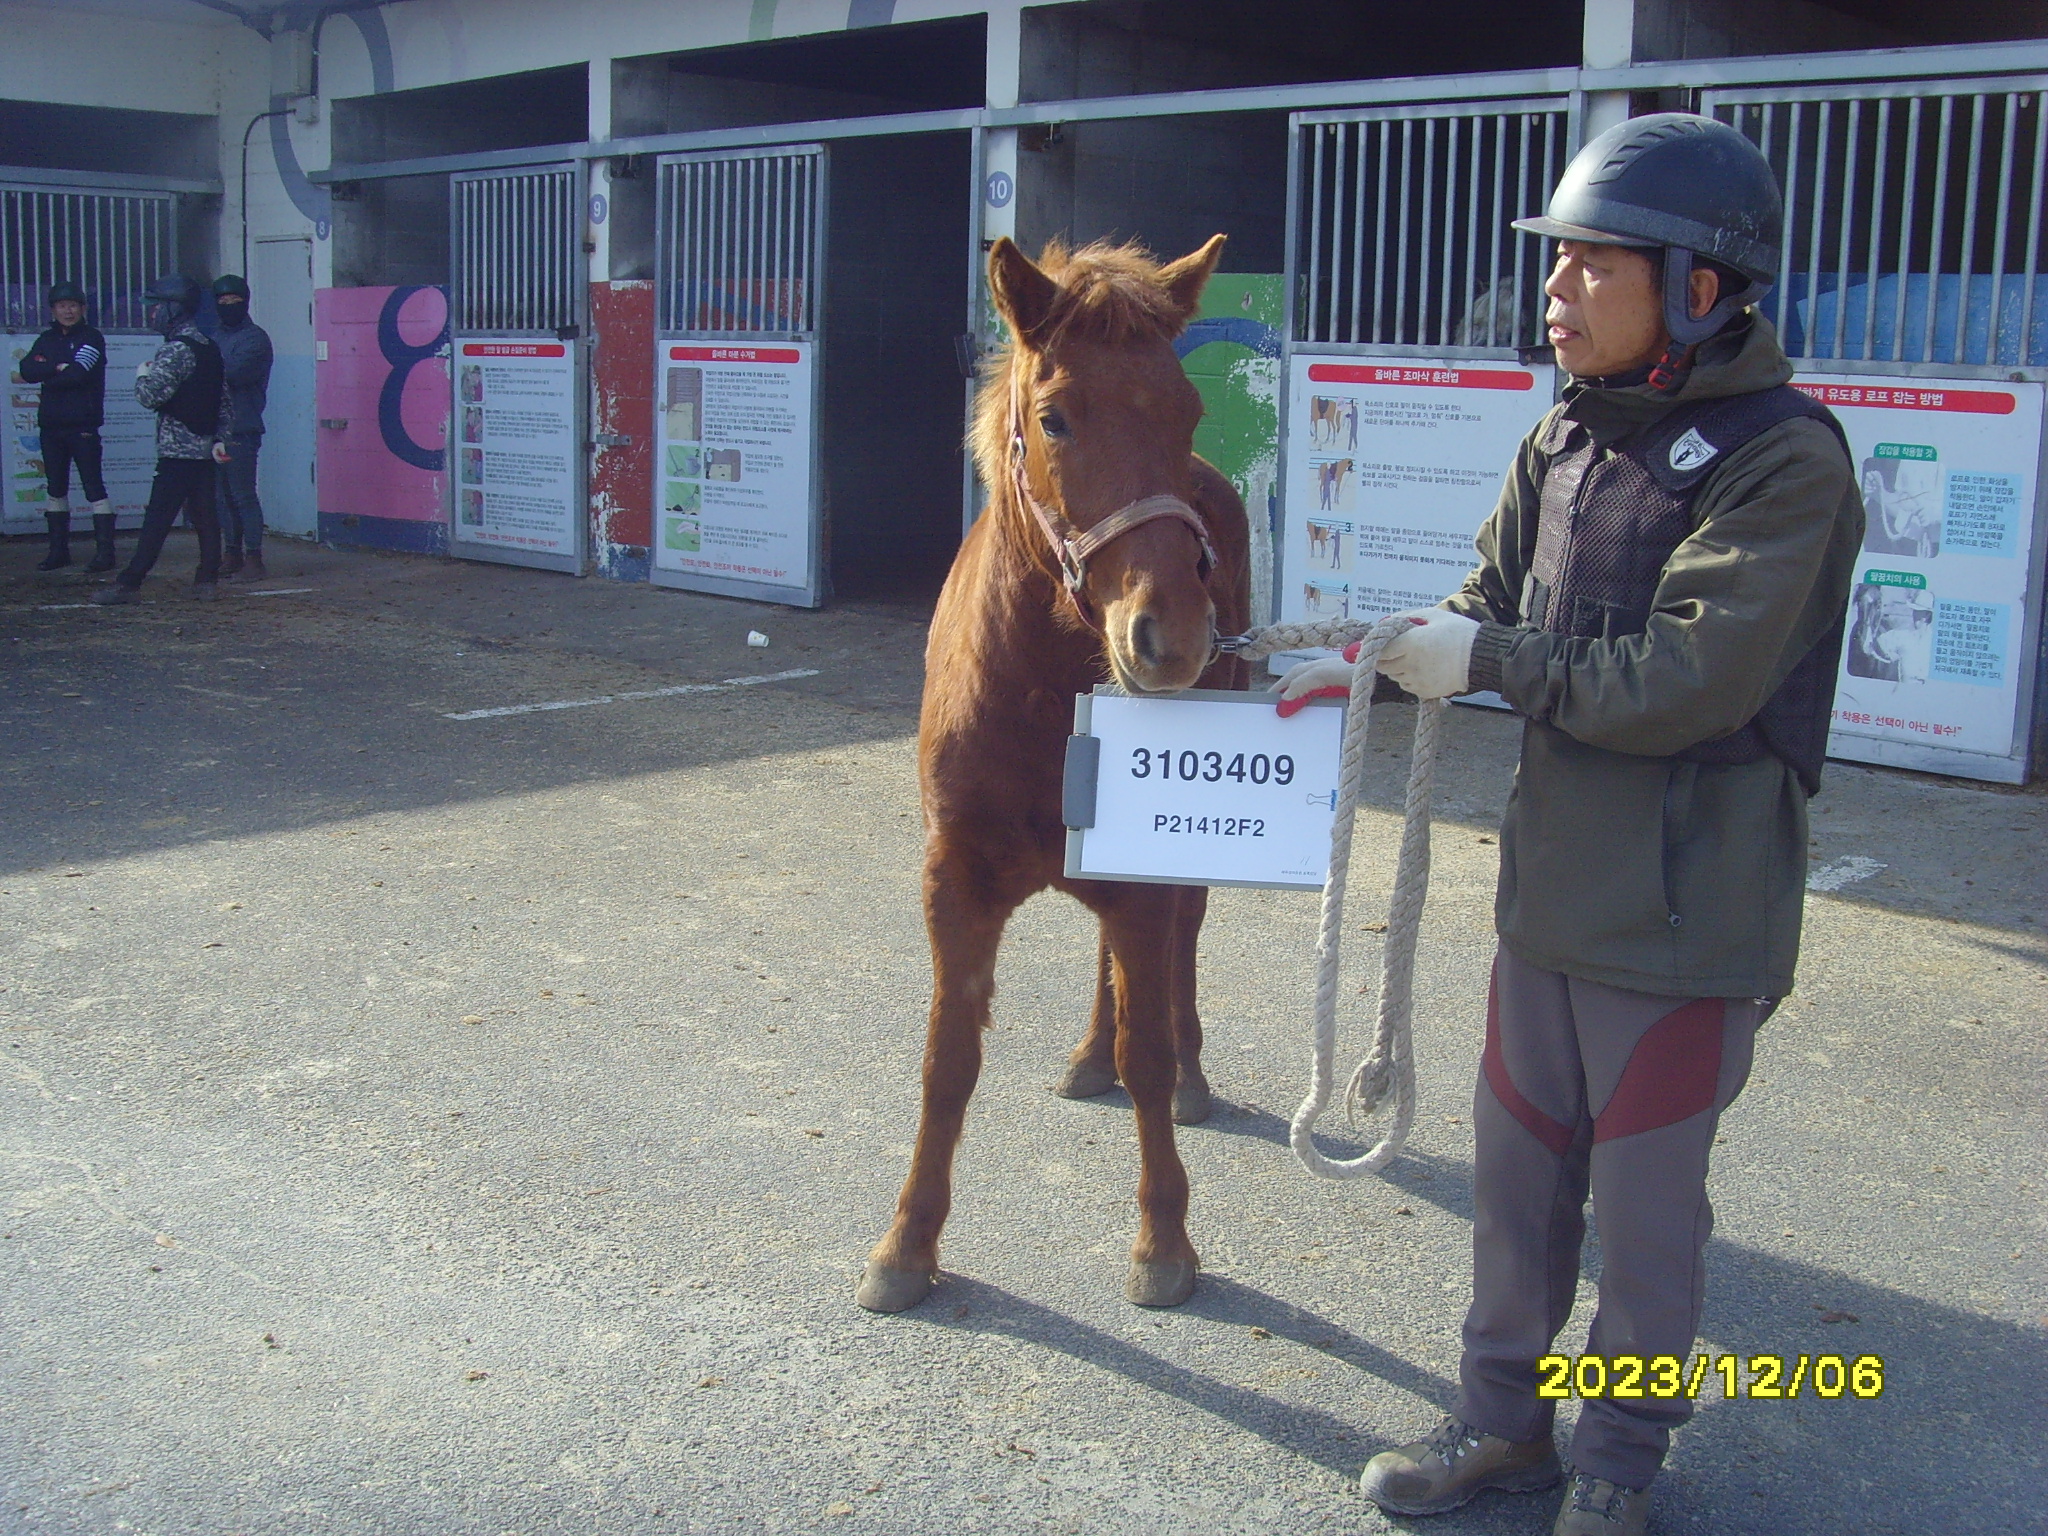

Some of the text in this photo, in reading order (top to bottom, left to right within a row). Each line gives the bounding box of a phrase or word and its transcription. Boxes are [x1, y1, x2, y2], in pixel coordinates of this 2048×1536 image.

[990, 179, 1007, 200] 10
[593, 201, 601, 218] 9
[318, 221, 326, 235] 8
[1375, 368, 1459, 383] 올바른 조마삭 훈련법
[1828, 388, 1943, 407] 유도용 로프 잡는 방법
[1902, 446, 1923, 458] 착용할
[1925, 448, 1933, 459] 것
[1870, 571, 1920, 586] 팔꿈치의 사용
[1842, 710, 1871, 725] 착용은
[1875, 715, 1904, 730] 선택이
[1908, 720, 1928, 733] 아닌
[1131, 747, 1295, 785] 3103409
[1154, 814, 1265, 837] P21412F2
